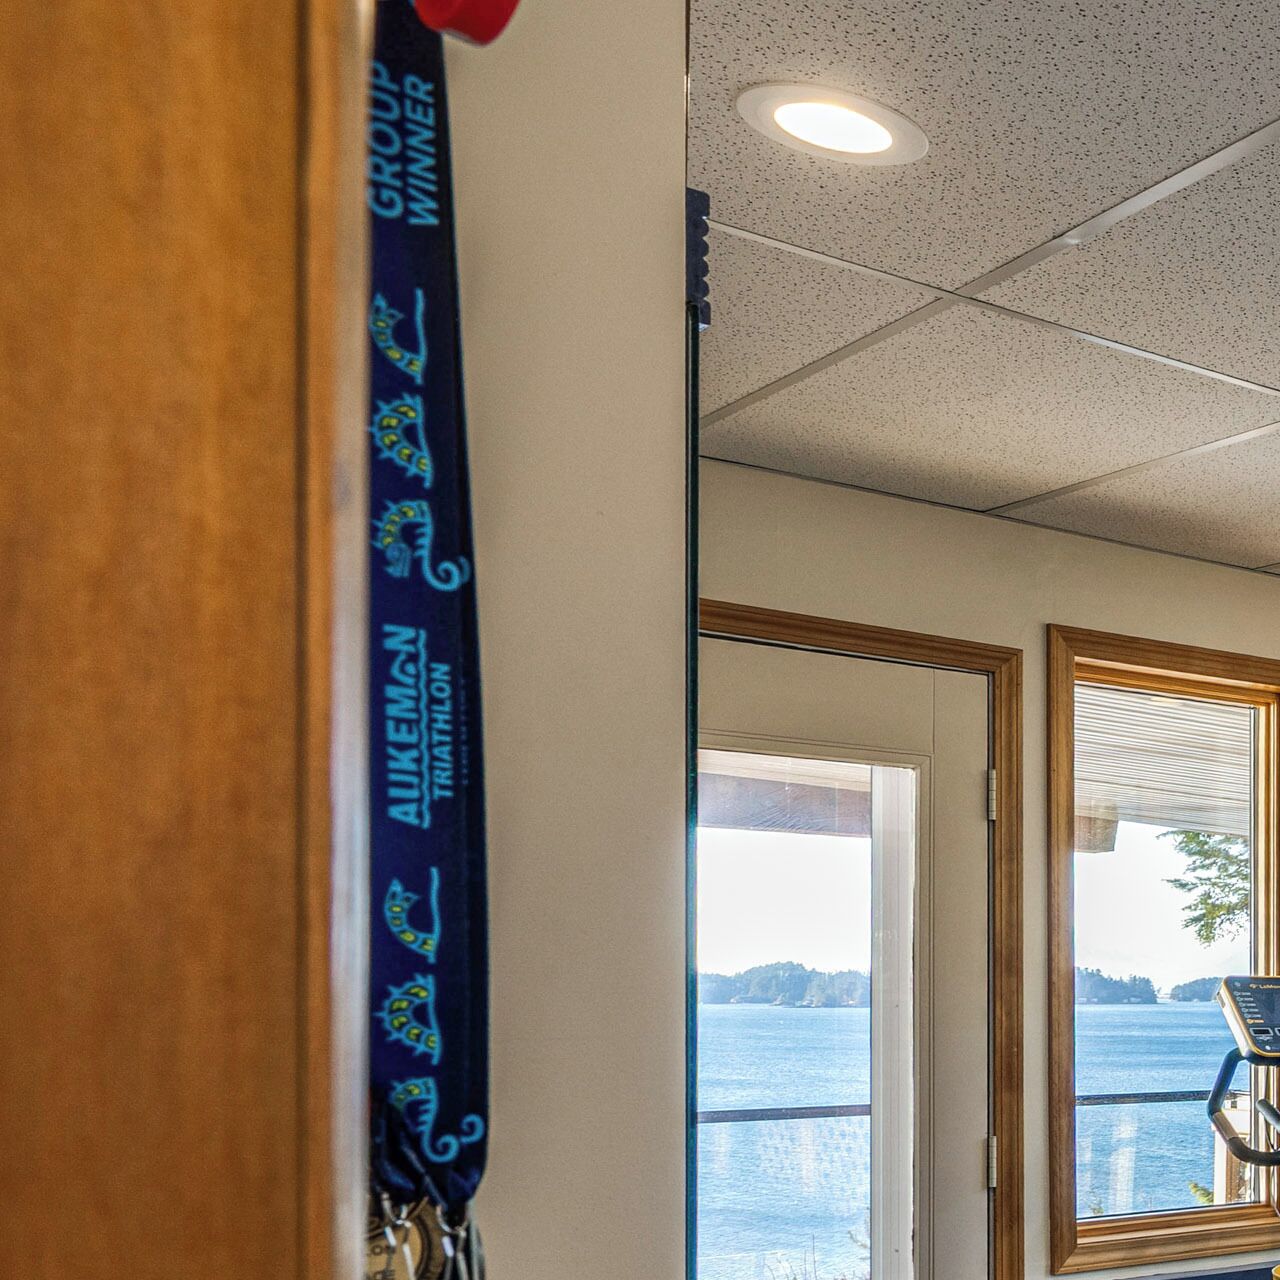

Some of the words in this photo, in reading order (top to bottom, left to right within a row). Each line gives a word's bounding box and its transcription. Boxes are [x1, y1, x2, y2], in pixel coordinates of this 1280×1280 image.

[365, 60, 404, 219] GROUP
[402, 74, 440, 226] WINNER
[429, 662, 453, 801] TRIATHLON
